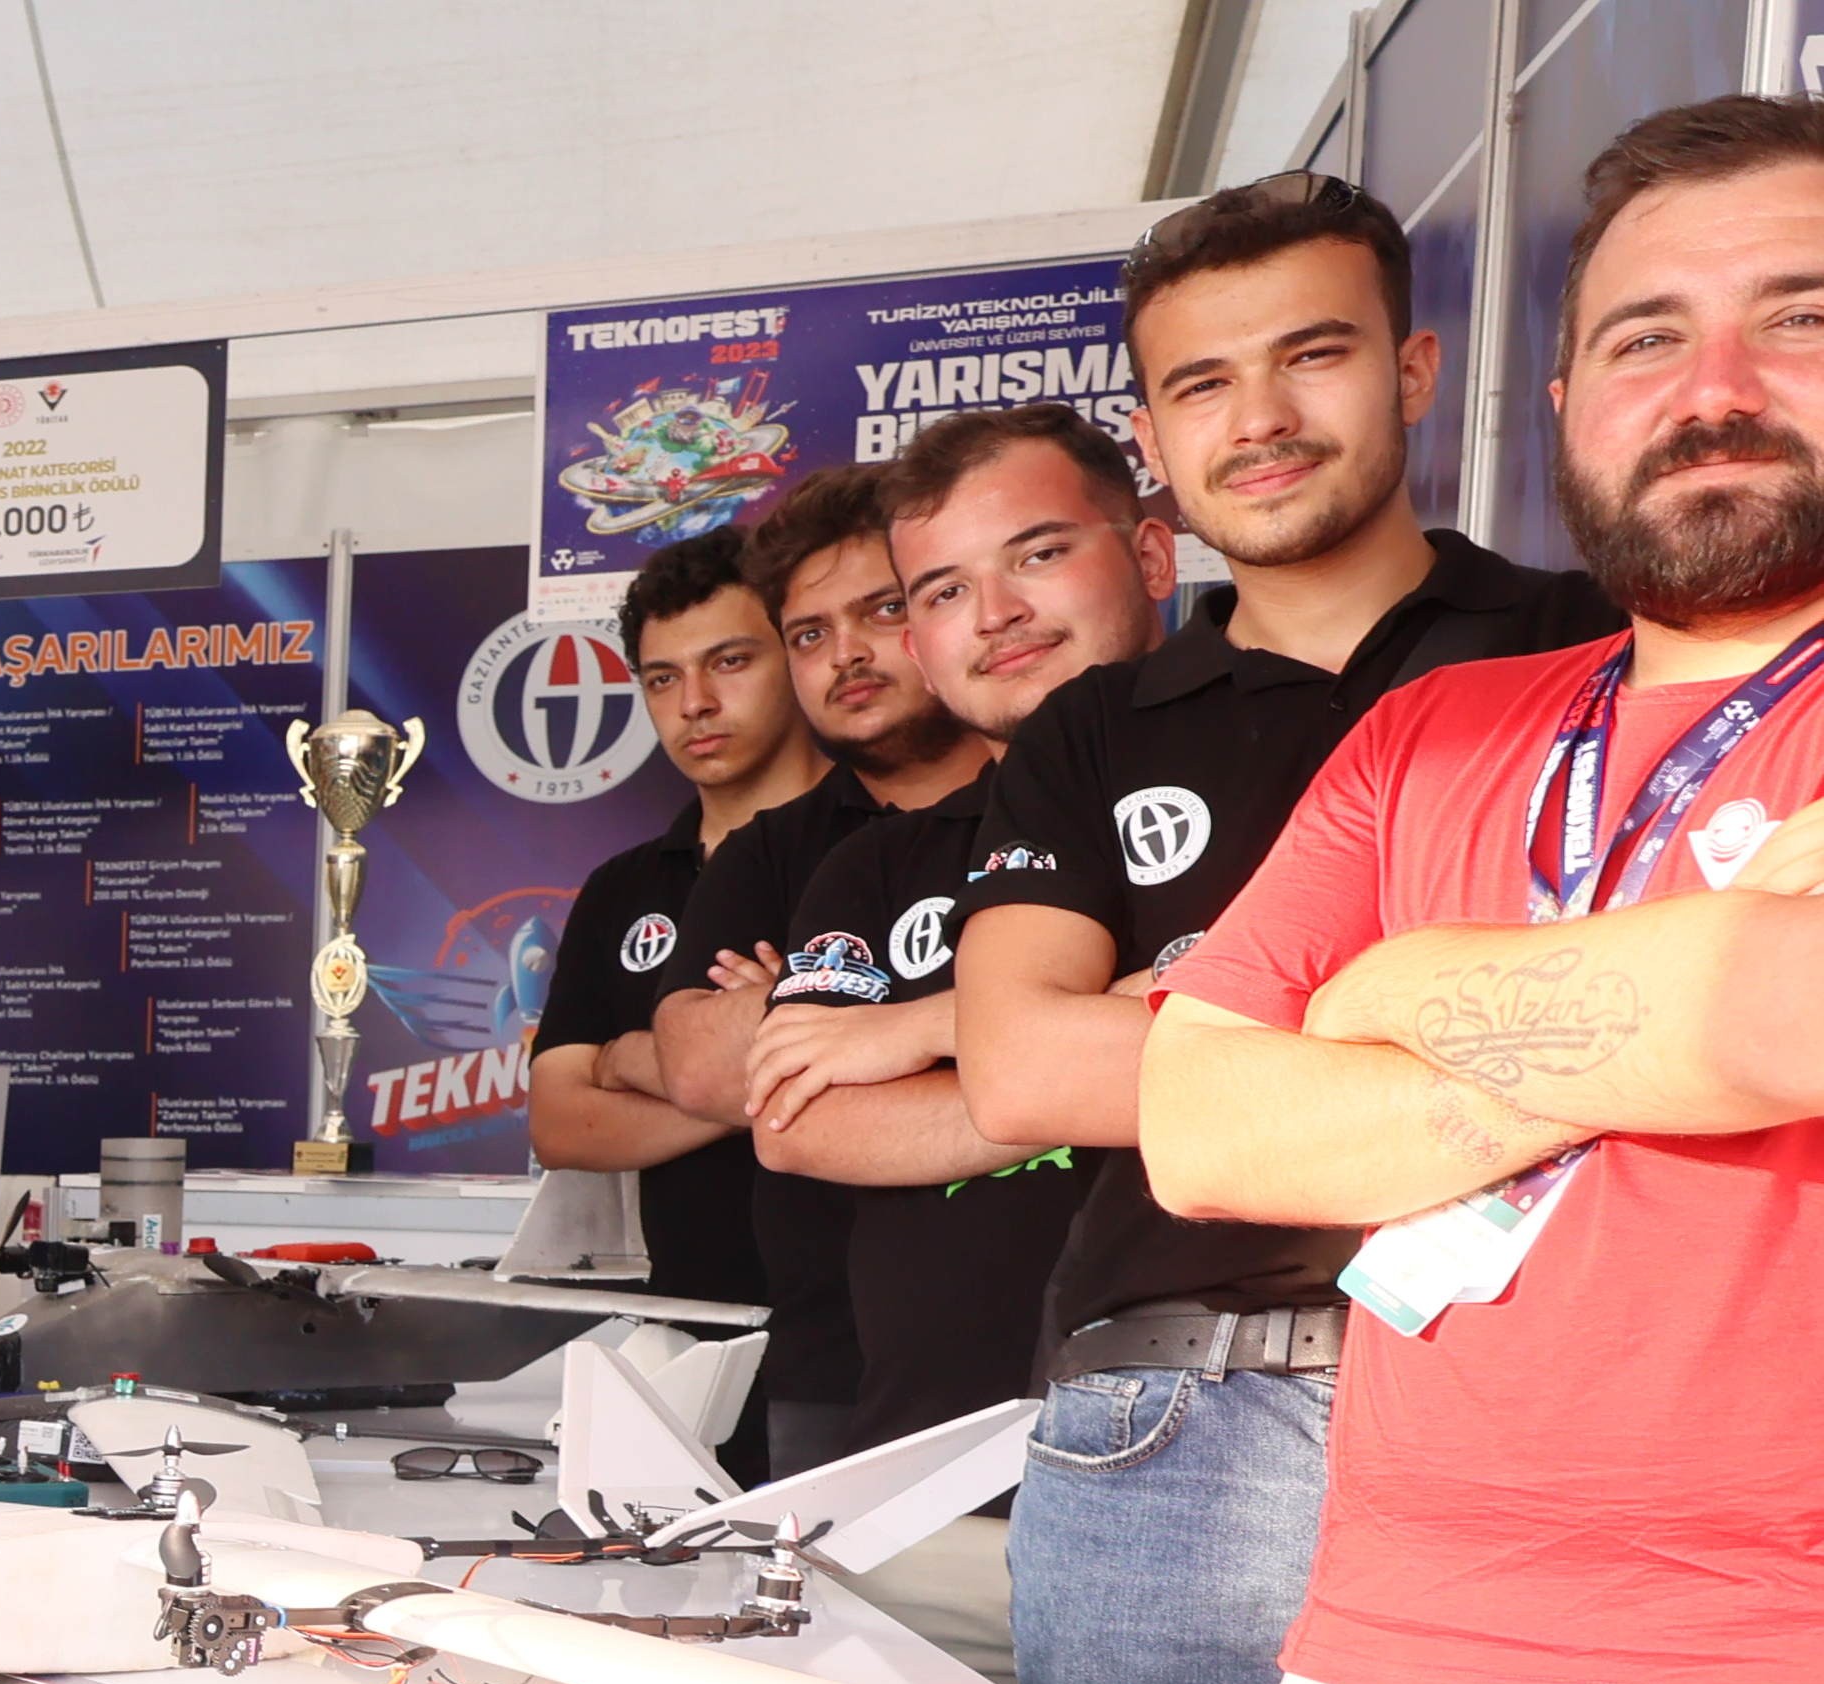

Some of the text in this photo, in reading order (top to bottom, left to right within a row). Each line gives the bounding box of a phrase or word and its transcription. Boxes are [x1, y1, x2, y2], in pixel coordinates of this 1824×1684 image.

[867, 303, 960, 325] TURİZM
[941, 309, 1076, 333] YARIŞMASI
[567, 308, 783, 352] TEKNOFEST
[987, 335, 1004, 347] VE
[1007, 330, 1046, 345] ÜZERİ
[1048, 323, 1106, 342] SEVİYESİ
[710, 340, 780, 364] 2023
[3, 439, 47, 457] 2022
[29, 457, 117, 478] KATEGORİSİ
[11, 481, 86, 499] BİRİNCİLİK
[88, 474, 141, 493] ÖDÜLÜ
[534, 779, 585, 796] 1973
